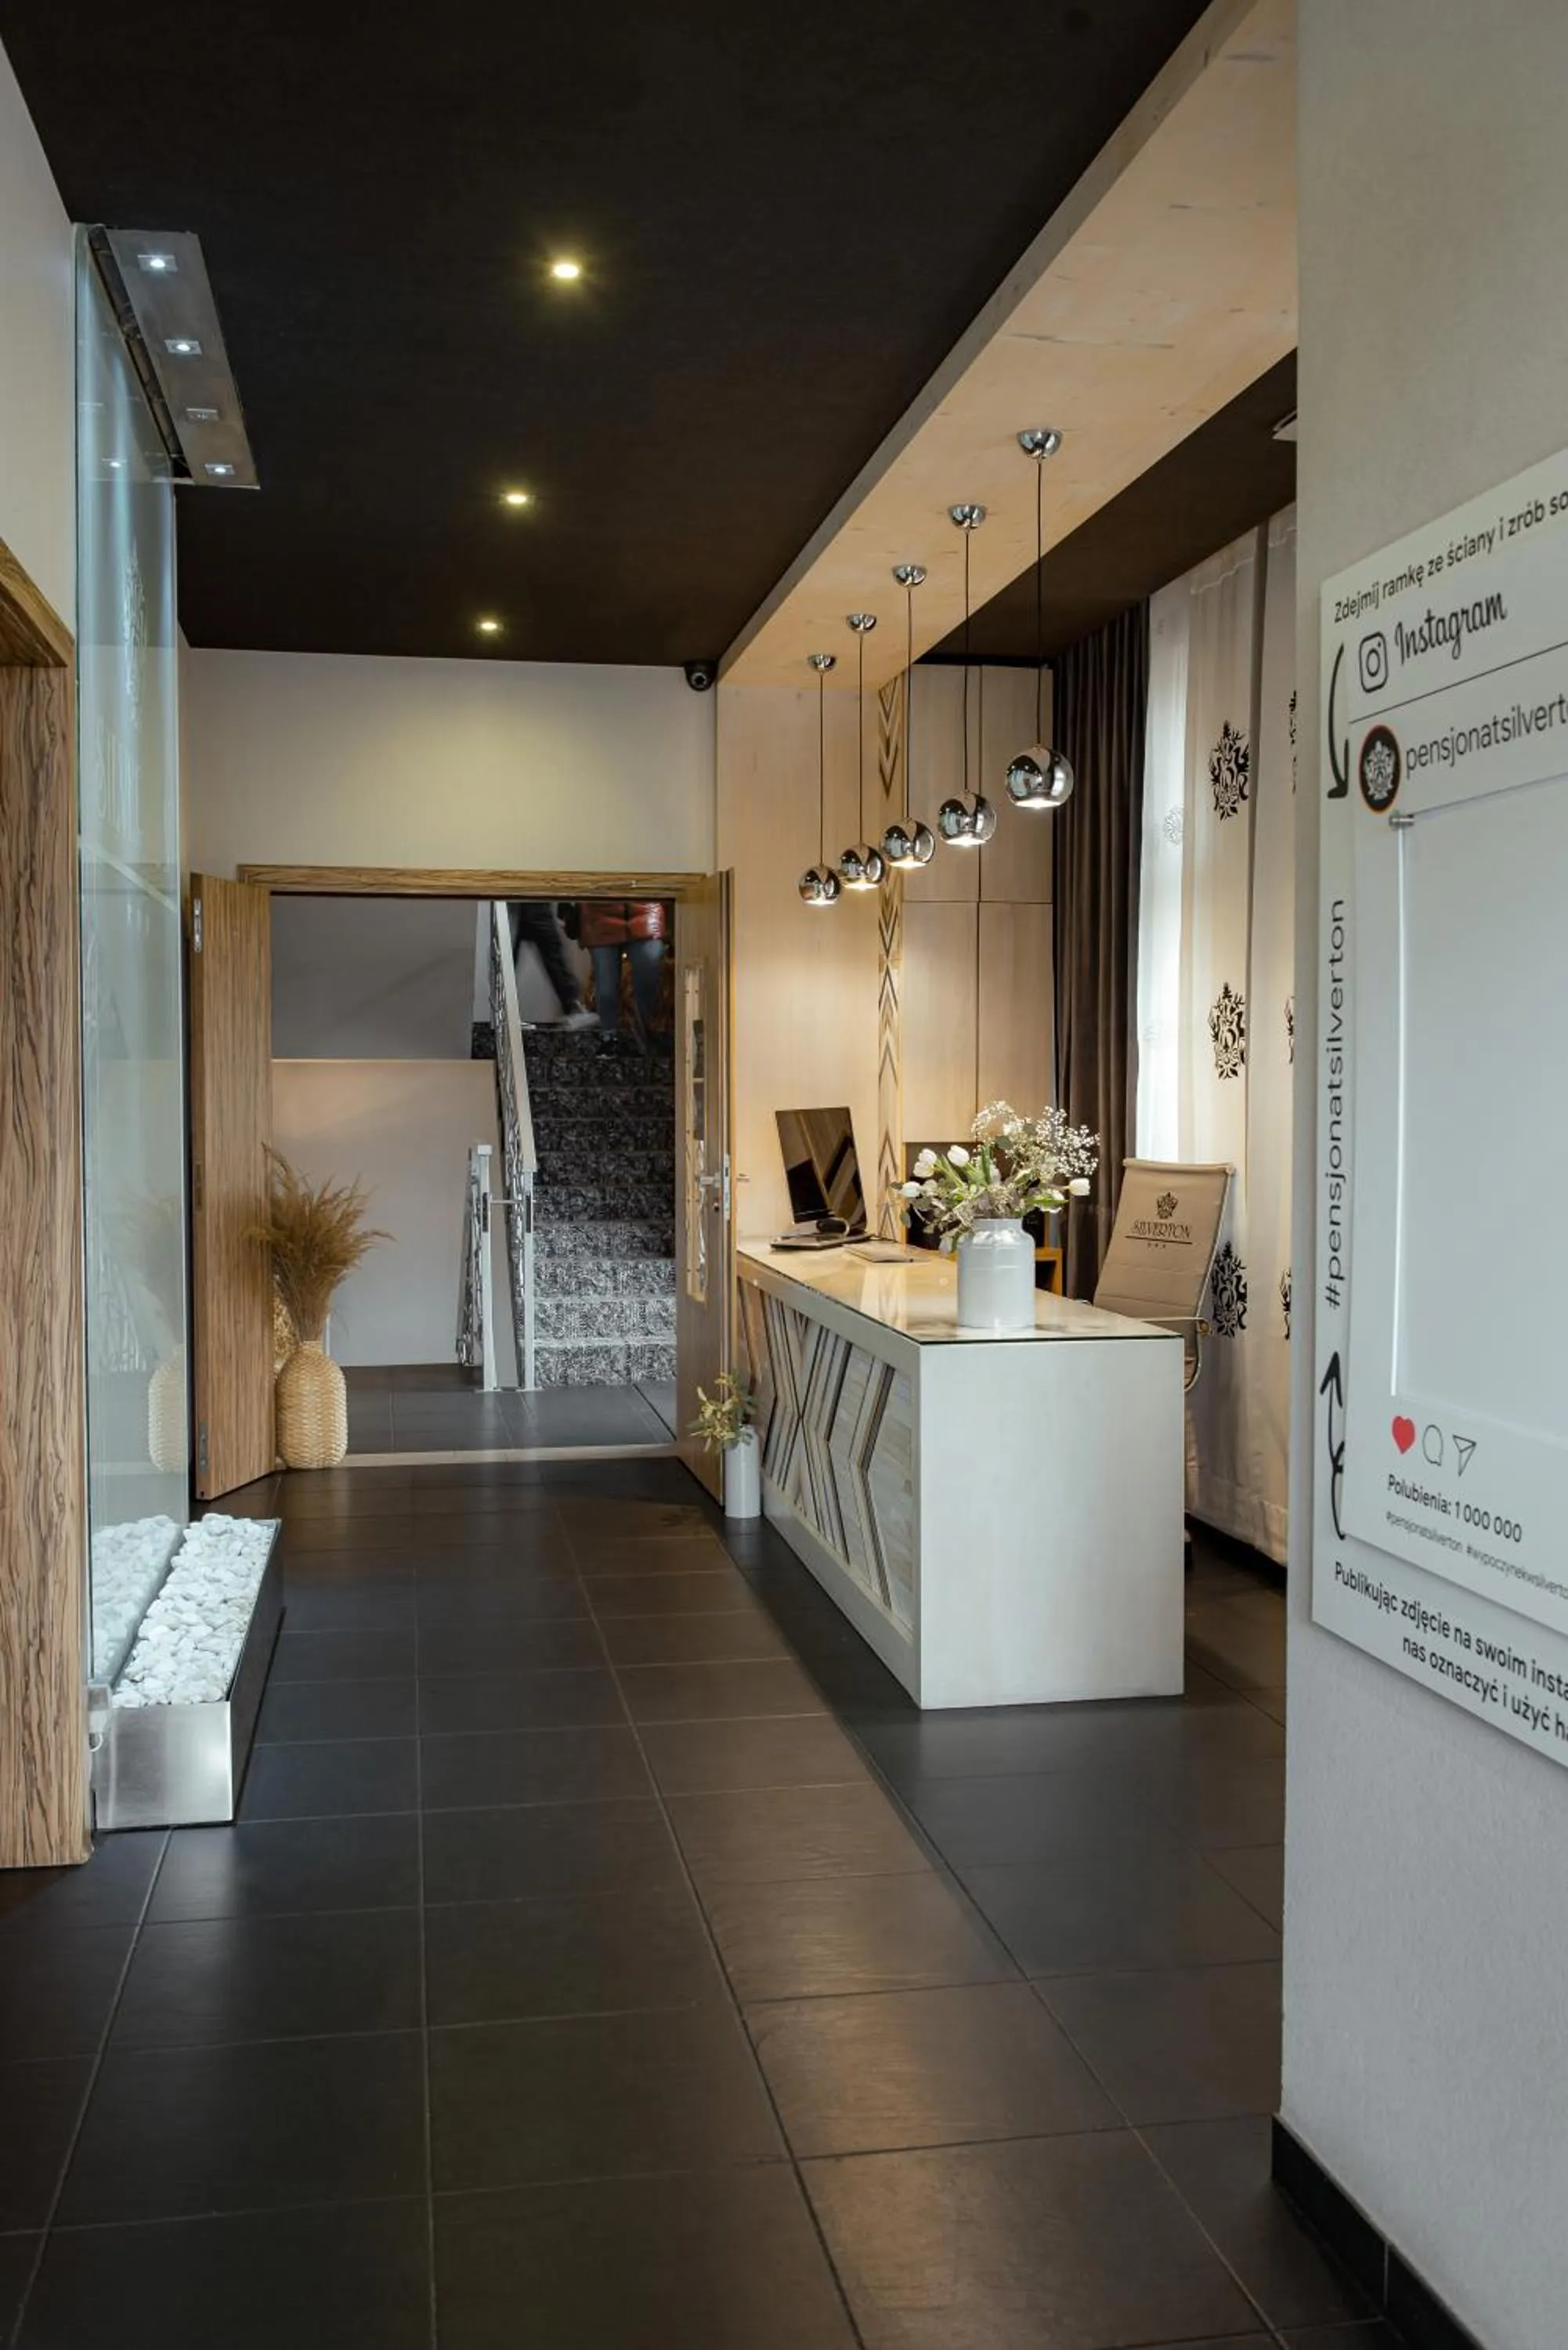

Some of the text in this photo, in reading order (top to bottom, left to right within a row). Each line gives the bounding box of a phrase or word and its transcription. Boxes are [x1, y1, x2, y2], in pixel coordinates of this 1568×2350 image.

[1334, 581, 1379, 624] Zdejmij
[1382, 565, 1424, 600] ramkę
[1428, 555, 1444, 577] ze
[1447, 527, 1495, 567] ściany
[1499, 516, 1504, 540] i
[1508, 499, 1545, 537] zrób
[1394, 591, 1508, 665] Instagram
[1406, 692, 1568, 780] pensjonatsilvert
[1324, 898, 1347, 1308] #pensjonatsilverton
[1455, 1501, 1460, 1520] 1
[1464, 1504, 1490, 1530] 000
[1494, 1516, 1522, 1542] 000
[1335, 1560, 1398, 1614] Publikując
[1400, 1600, 1450, 1639] zdjęcie
[1454, 1627, 1472, 1649] na
[1476, 1638, 1526, 1678] swoim
[1403, 1636, 1568, 1741] nas oznaczyć i użyć h
